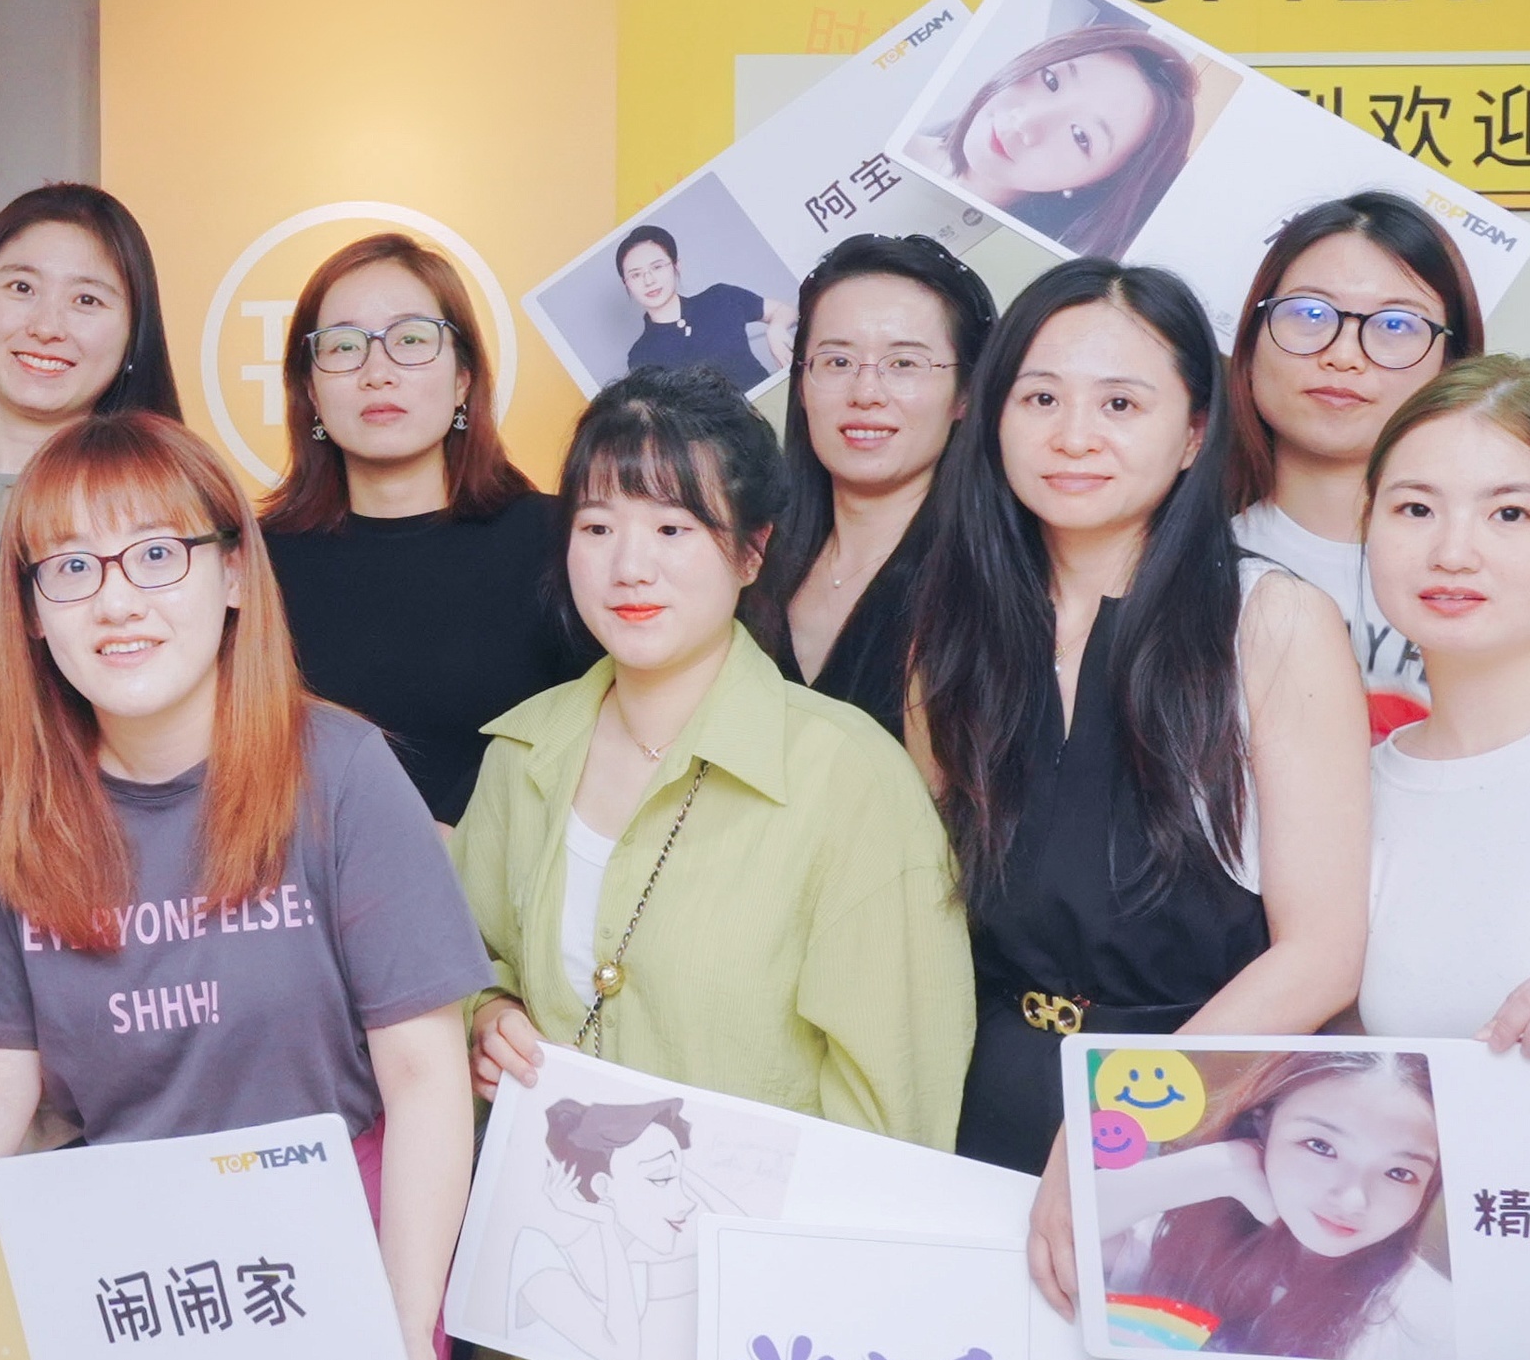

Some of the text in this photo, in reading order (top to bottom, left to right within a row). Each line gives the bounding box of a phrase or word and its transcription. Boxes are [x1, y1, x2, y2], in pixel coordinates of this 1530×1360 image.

[872, 9, 954, 71] TOPTEAM
[804, 152, 902, 233] 阿宝
[1424, 189, 1518, 253] TOPTEAM
[220, 884, 315, 934] ELSE:
[108, 980, 220, 1034] SHHH!
[209, 1141, 327, 1176] TOPTEAM
[95, 1256, 307, 1345] 闹闹家
